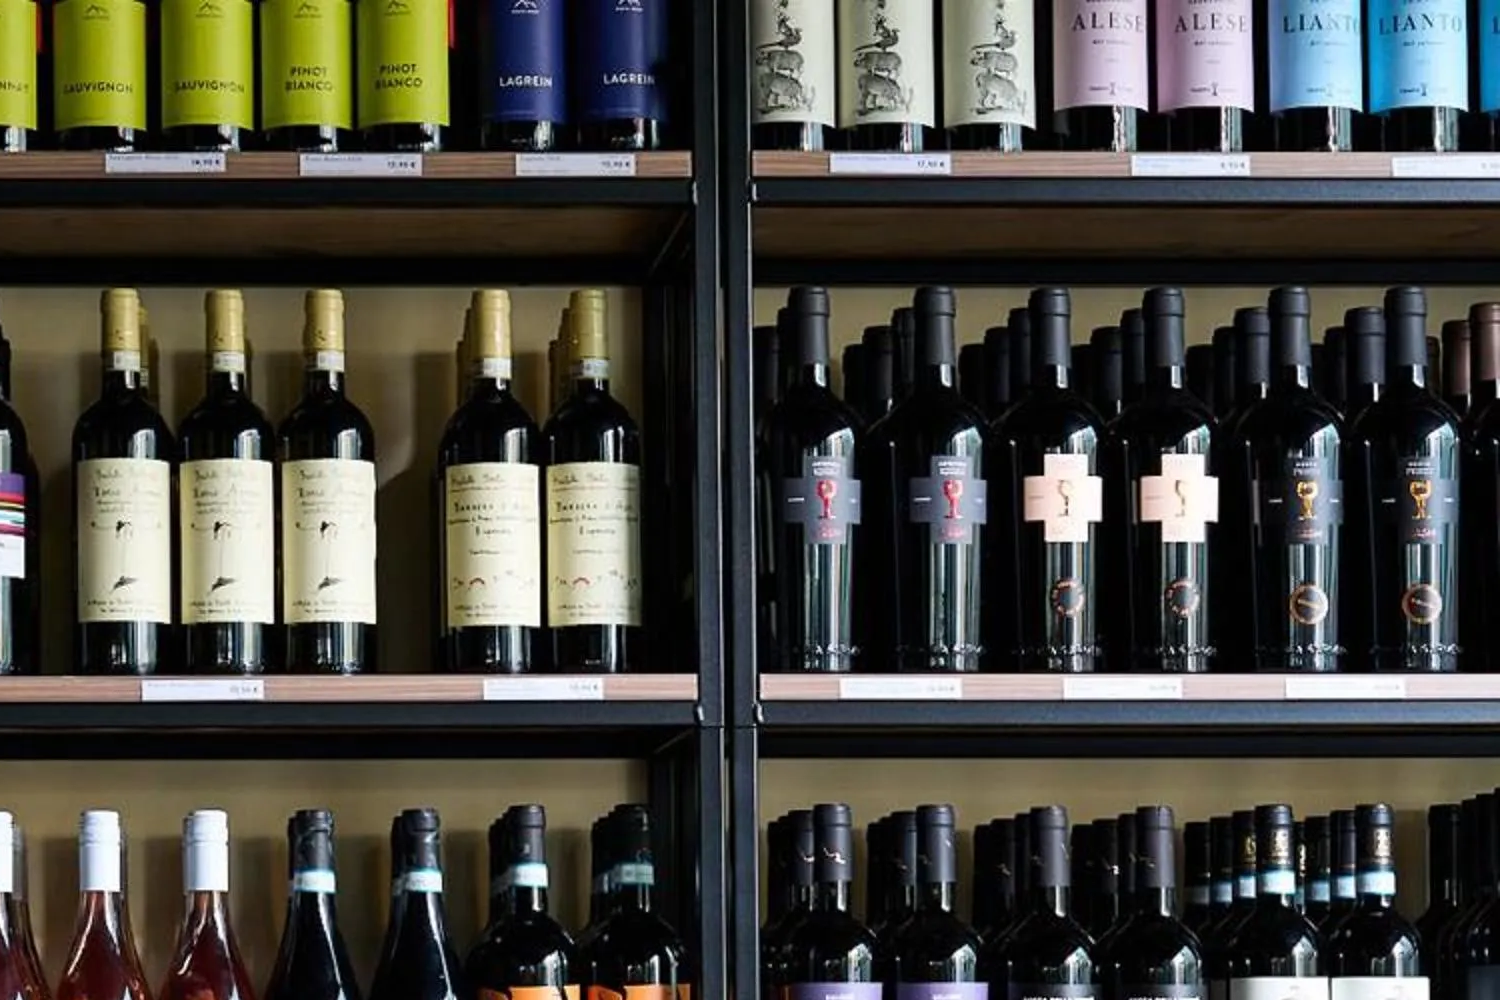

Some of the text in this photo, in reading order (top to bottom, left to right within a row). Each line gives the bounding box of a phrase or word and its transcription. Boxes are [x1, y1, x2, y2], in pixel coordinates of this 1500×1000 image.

[1071, 12, 1145, 33] ALESE
[1174, 12, 1248, 33] ALESE
[1378, 13, 1463, 36] LIANTO
[289, 65, 327, 78] PINOT
[379, 63, 418, 76] PINOT
[285, 79, 334, 93] BIANCO
[375, 77, 423, 91] BIANCO
[500, 73, 553, 88] LAGREIN
[603, 72, 655, 85] LAGREIN
[64, 80, 134, 95] SAUVIGNON
[174, 79, 245, 95] SAUVIGNON
